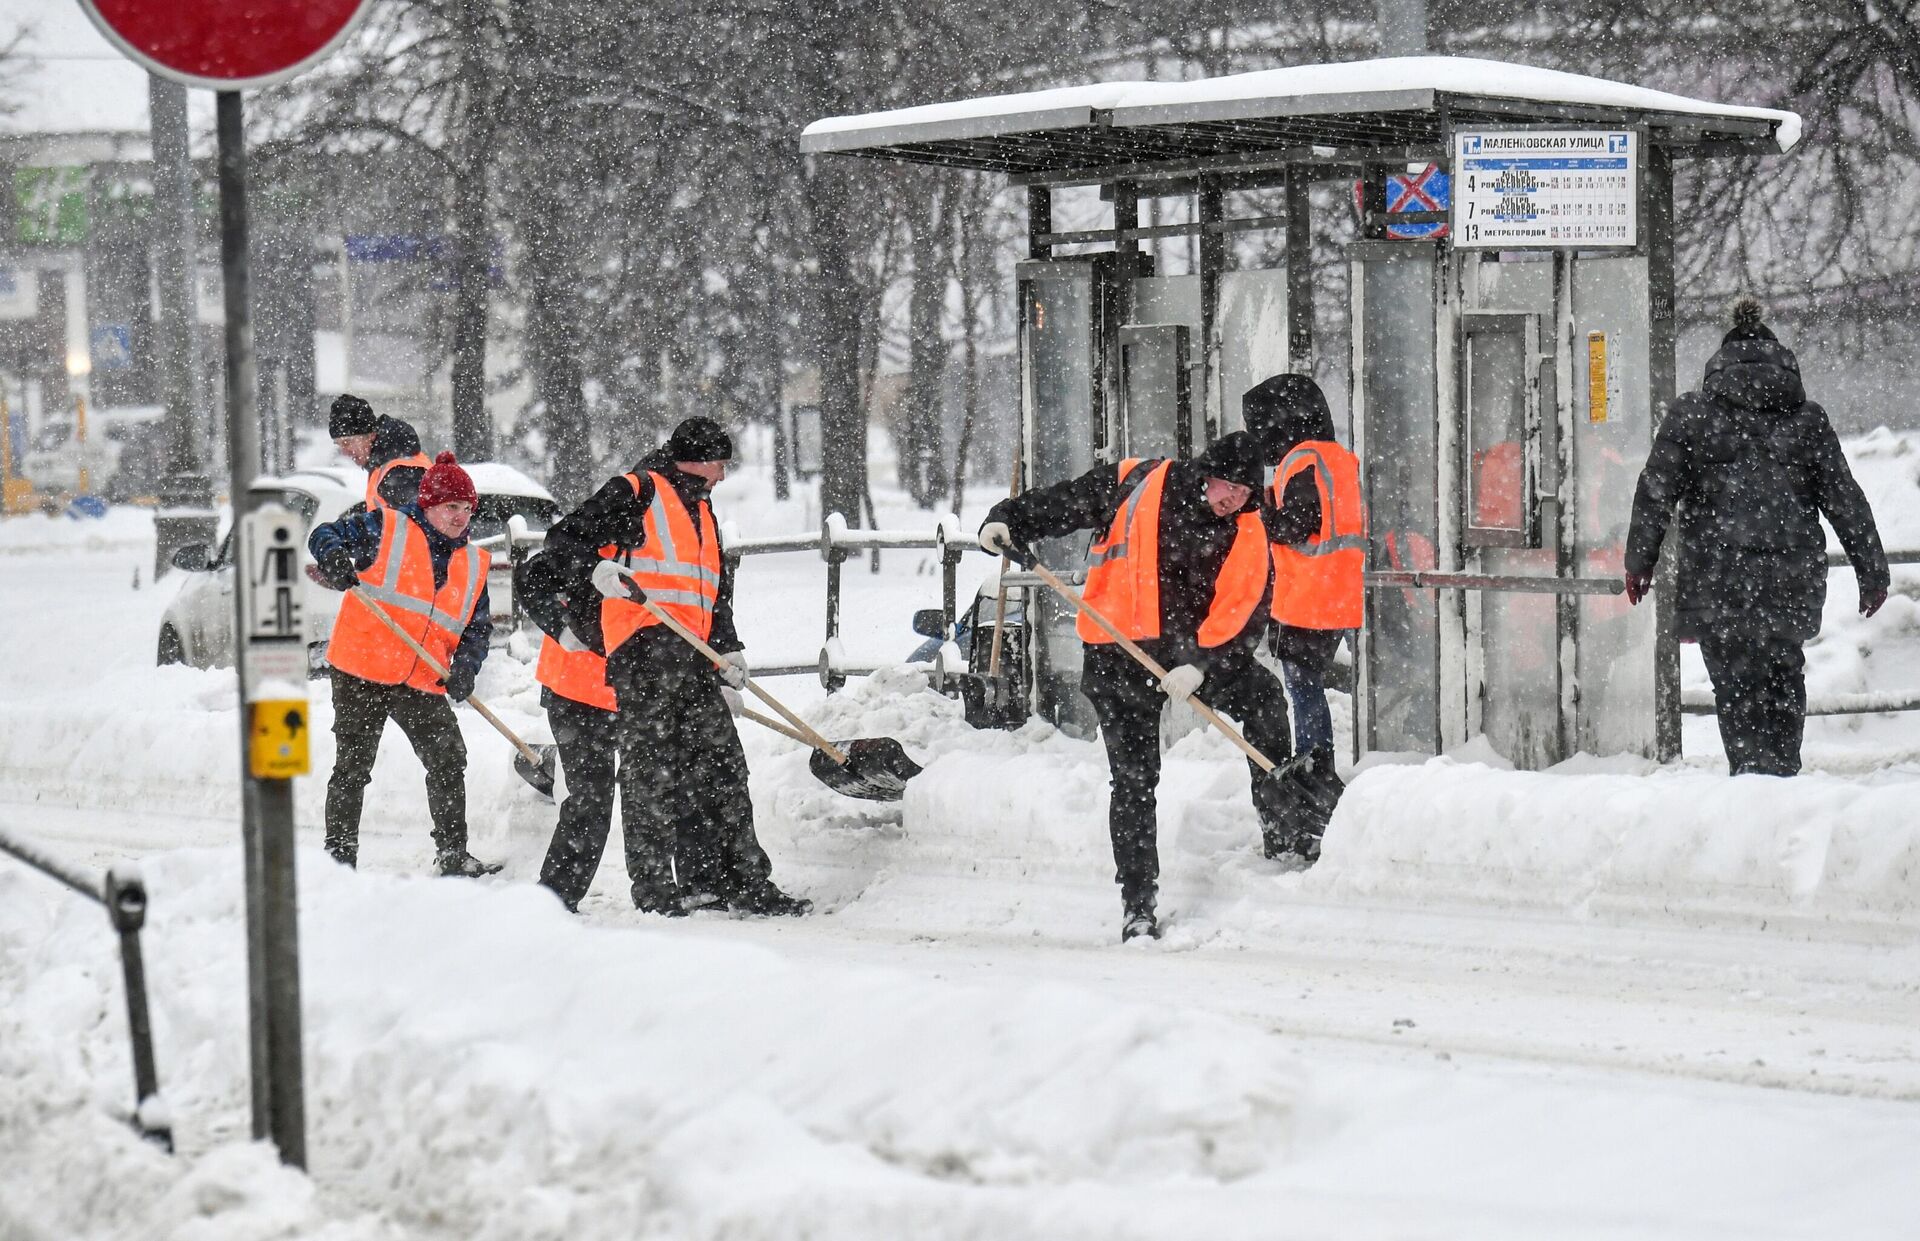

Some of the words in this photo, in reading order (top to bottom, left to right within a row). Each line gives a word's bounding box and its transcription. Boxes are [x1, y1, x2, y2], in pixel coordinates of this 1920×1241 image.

[1484, 137, 1567, 149] МАЛЕНКОВСКАЯ
[1569, 137, 1605, 149] УЛИЦА
[1468, 175, 1475, 192] 4
[1468, 202, 1475, 219] 7
[1465, 224, 1478, 241] 13
